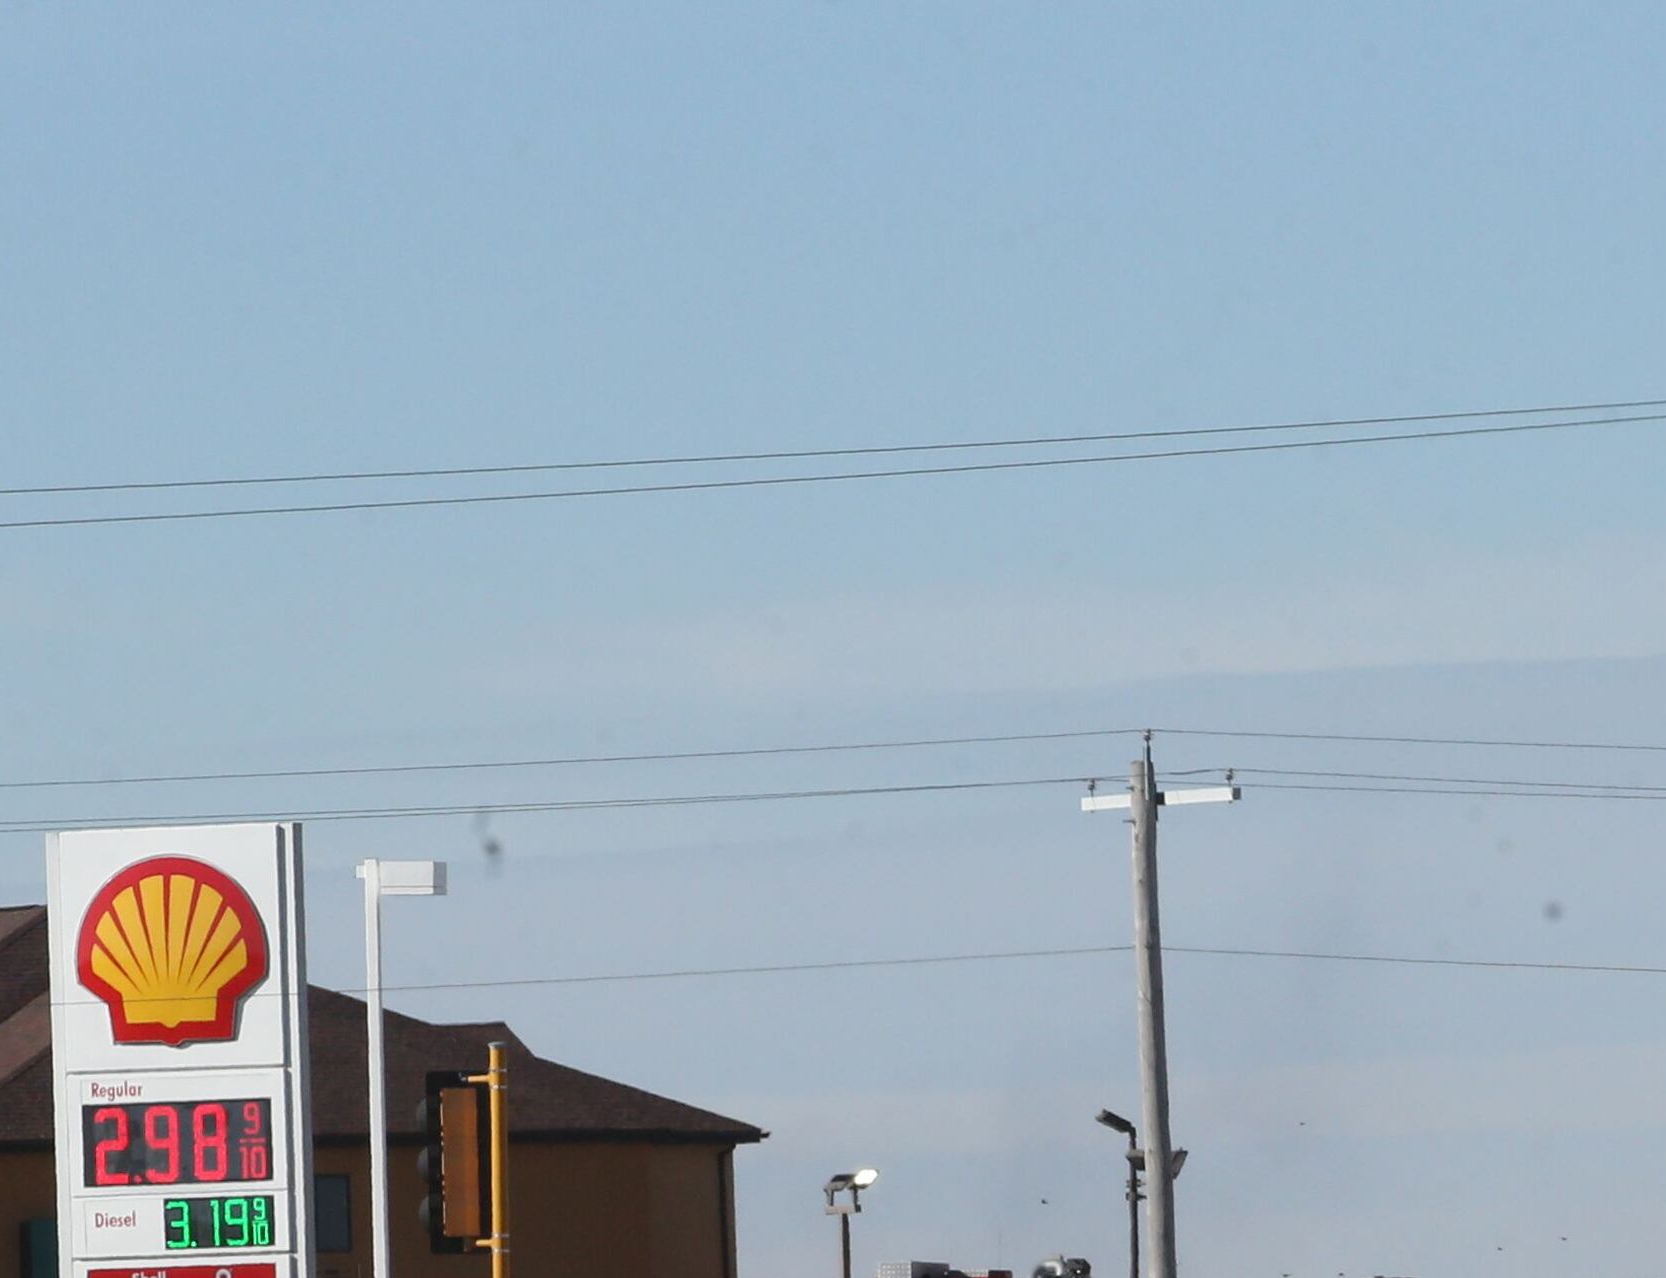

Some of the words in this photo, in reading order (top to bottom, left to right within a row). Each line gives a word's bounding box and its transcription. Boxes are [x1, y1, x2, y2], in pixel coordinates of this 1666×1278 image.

[91, 1080, 143, 1102] Regular
[93, 1102, 229, 1185] 2.98
[95, 1210, 137, 1229] Diesel
[166, 1199, 249, 1249] 3.19
